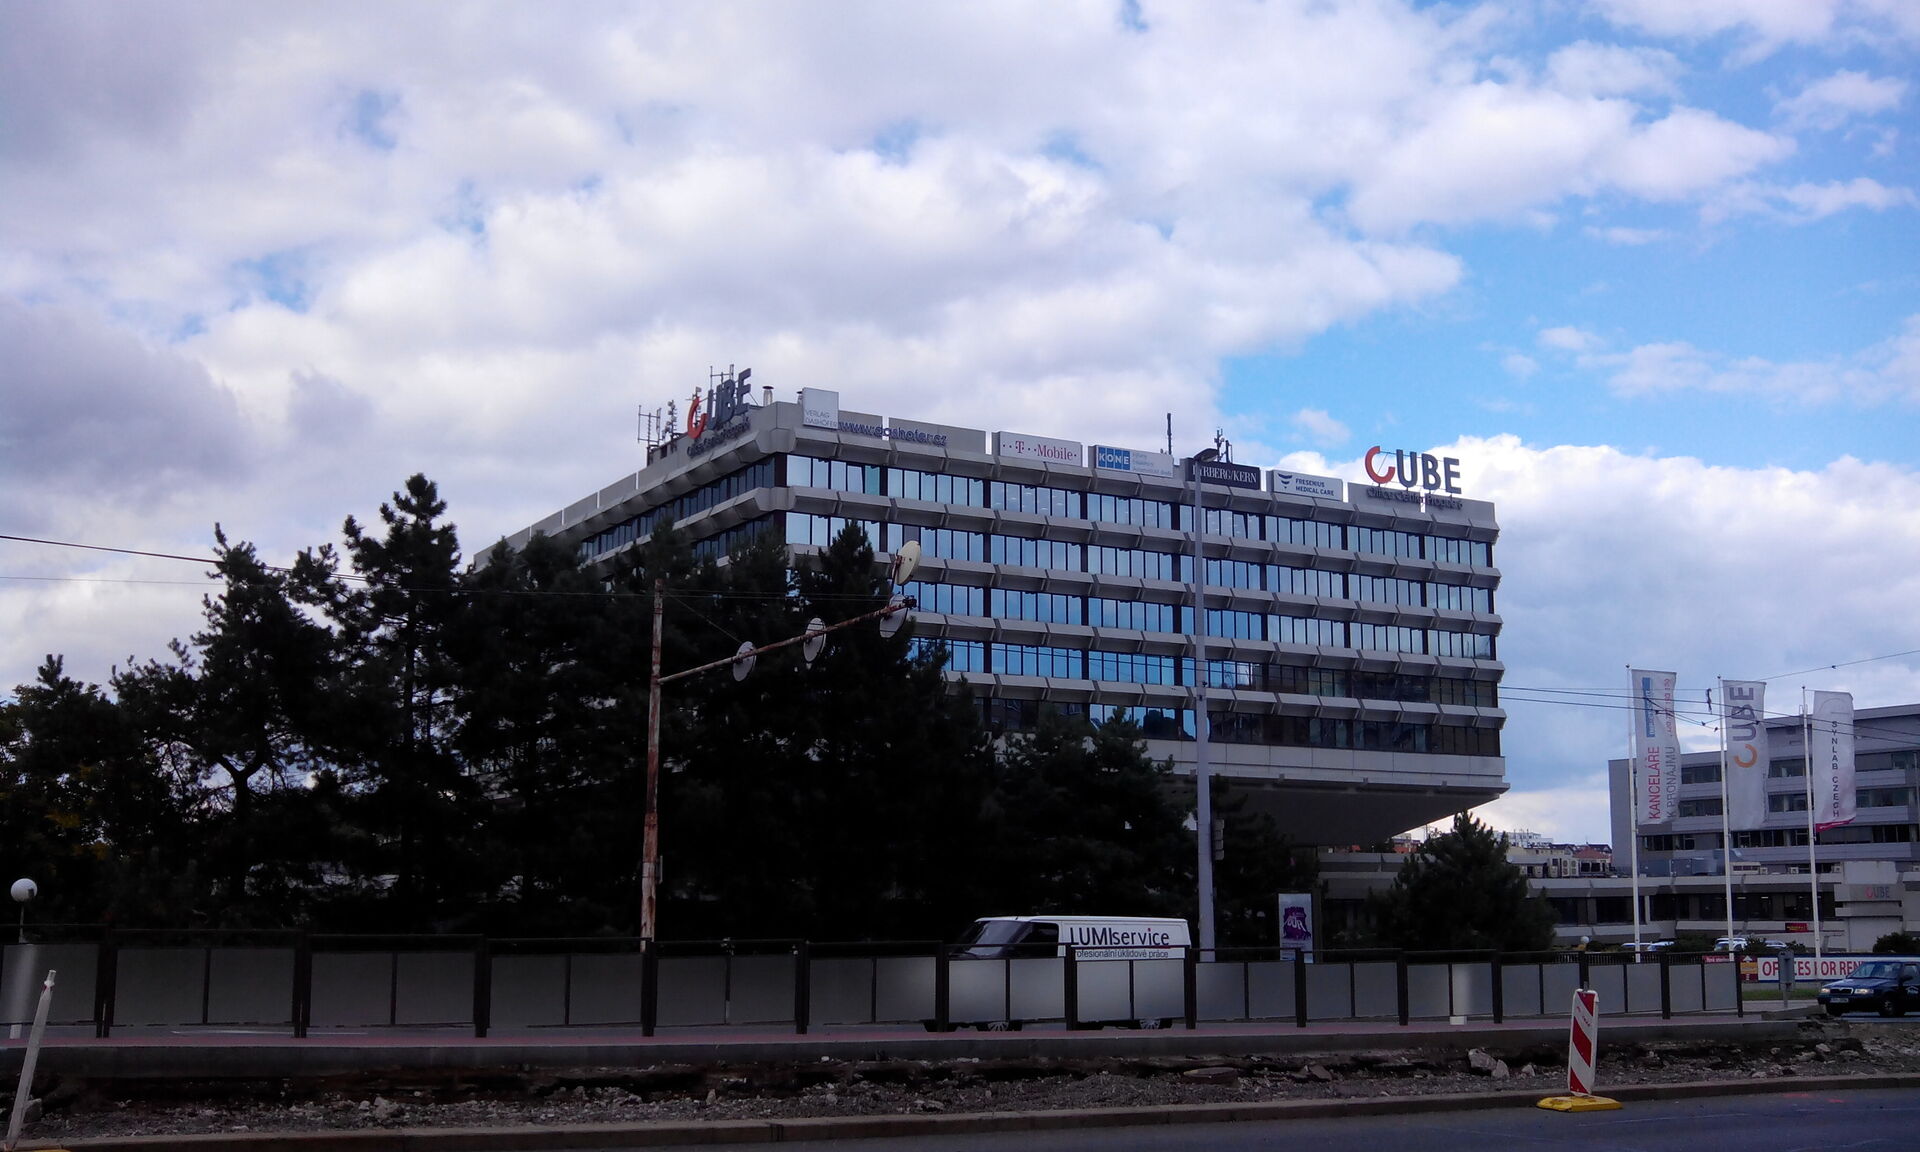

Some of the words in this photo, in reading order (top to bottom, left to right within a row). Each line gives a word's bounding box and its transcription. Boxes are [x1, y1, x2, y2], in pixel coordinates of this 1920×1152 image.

[687, 368, 751, 440] CUBE
[1098, 453, 1130, 465] KONE
[1365, 445, 1462, 495] CUBE
[1296, 478, 1325, 488] FRESENIUS
[1296, 486, 1319, 495] MEDICAL
[1320, 488, 1334, 496] CARE
[1729, 687, 1758, 769] CUBE
[1831, 720, 1839, 770] SYNLAB
[1832, 776, 1840, 818] CZECH
[1865, 886, 1890, 899] CUBE
[1070, 927, 1170, 946] LUMIservice
[1148, 949, 1169, 960] práce
